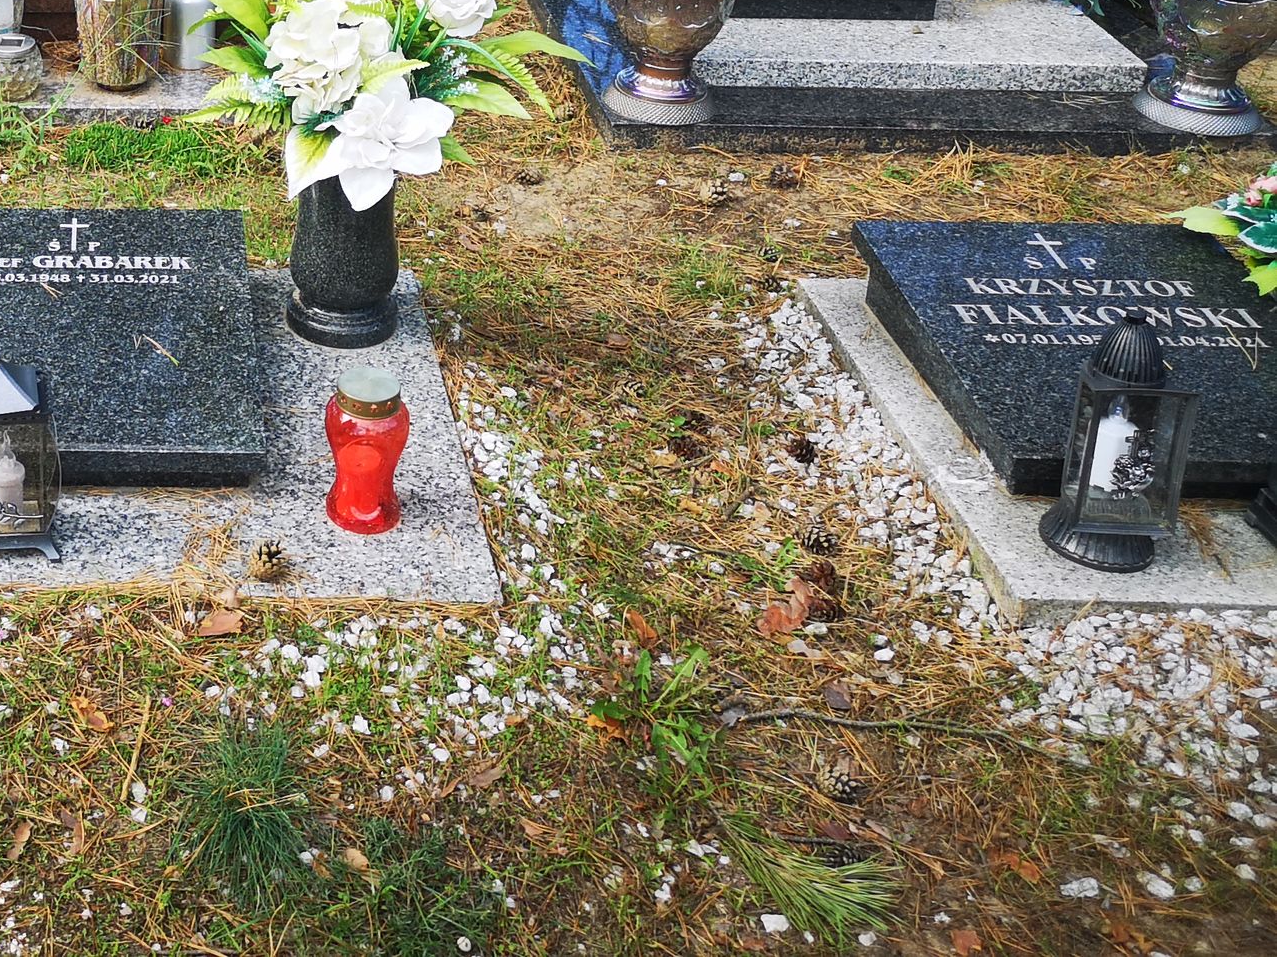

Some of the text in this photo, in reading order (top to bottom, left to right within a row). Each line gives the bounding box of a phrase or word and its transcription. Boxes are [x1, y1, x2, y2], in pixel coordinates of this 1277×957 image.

[32, 255, 192, 270] GRABAREK
[89, 273, 180, 284] 31.03.2021
[963, 277, 1196, 297] KRZYSZTOF
[1001, 332, 1101, 346] 07.01.195
